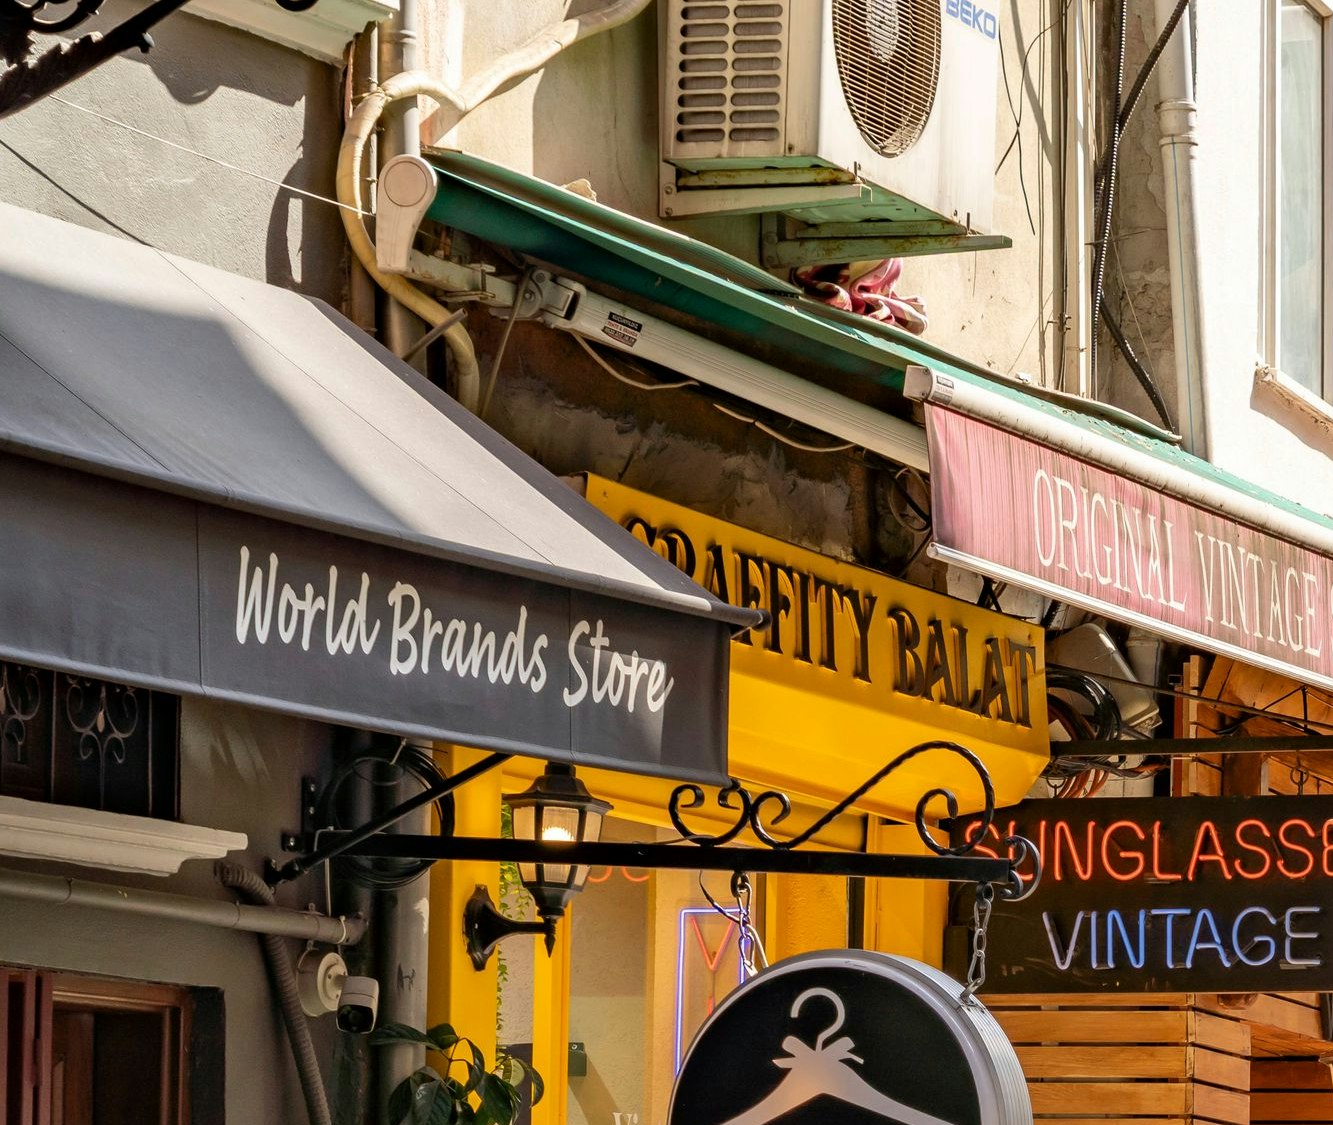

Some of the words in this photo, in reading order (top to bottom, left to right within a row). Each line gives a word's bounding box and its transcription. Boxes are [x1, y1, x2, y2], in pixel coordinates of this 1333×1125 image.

[946, 0, 996, 39] BEKO
[1033, 468, 1187, 611] ORIGINAL
[1193, 530, 1321, 658] VINTAGE
[235, 545, 381, 656] World
[387, 580, 549, 694] Brands
[563, 619, 675, 714] Store
[887, 606, 1037, 729] BALAT
[1042, 906, 1321, 970] VINTAGE
